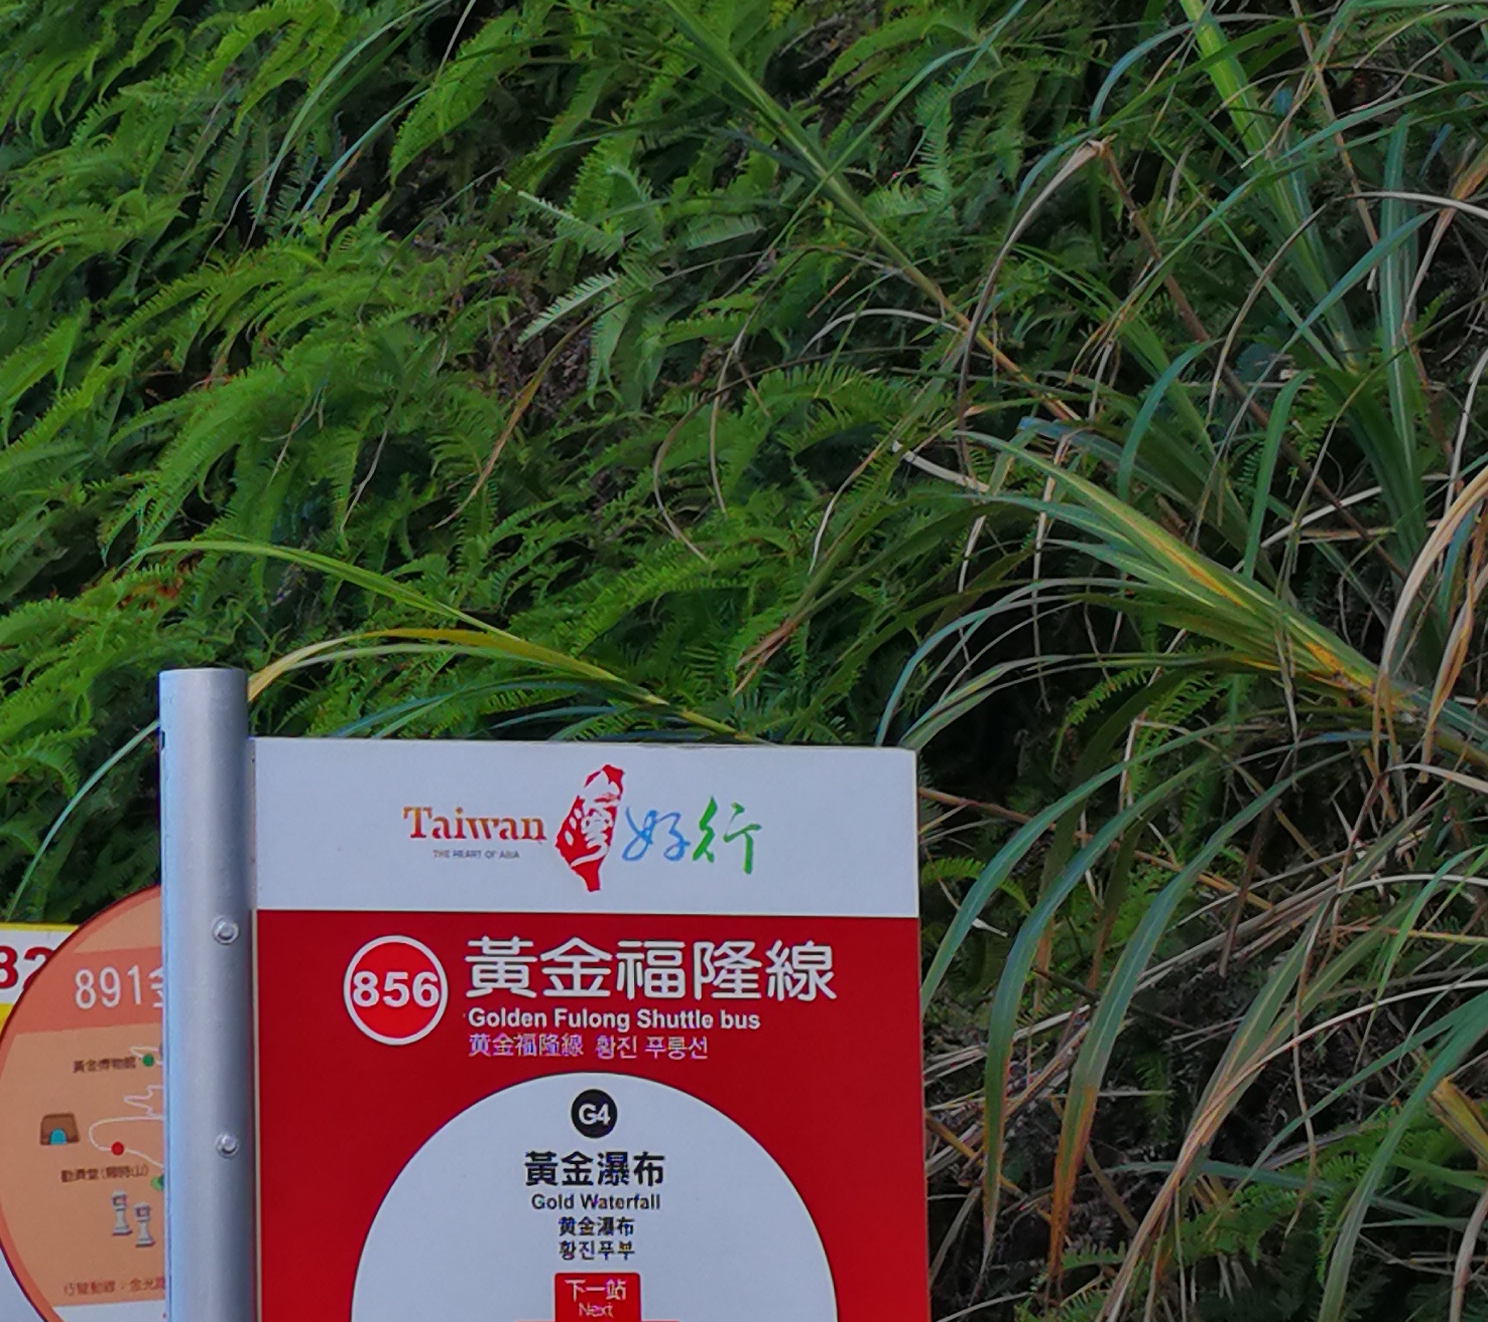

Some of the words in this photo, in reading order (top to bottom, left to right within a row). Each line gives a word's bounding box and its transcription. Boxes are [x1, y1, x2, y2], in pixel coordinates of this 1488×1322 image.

[403, 806, 547, 840] Taiwan
[621, 795, 762, 875] 好行
[433, 849, 450, 859] THE
[452, 849, 481, 859] HEART
[484, 849, 496, 859] OF
[499, 849, 520, 859] ASIA
[464, 935, 837, 1001] 黃金福隆線
[353, 970, 440, 1008] 856
[468, 1007, 547, 1028] Golden
[554, 1008, 630, 1032] Fulong
[637, 1009, 713, 1030] Shuttle
[720, 1009, 761, 1030] bus
[578, 1102, 611, 1126] G4
[524, 1151, 665, 1186] 黃金瀑布
[531, 1193, 574, 1210] Gold
[580, 1193, 660, 1210] Waterfall
[564, 1279, 627, 1302] 下一站
[578, 1302, 614, 1318] Next
